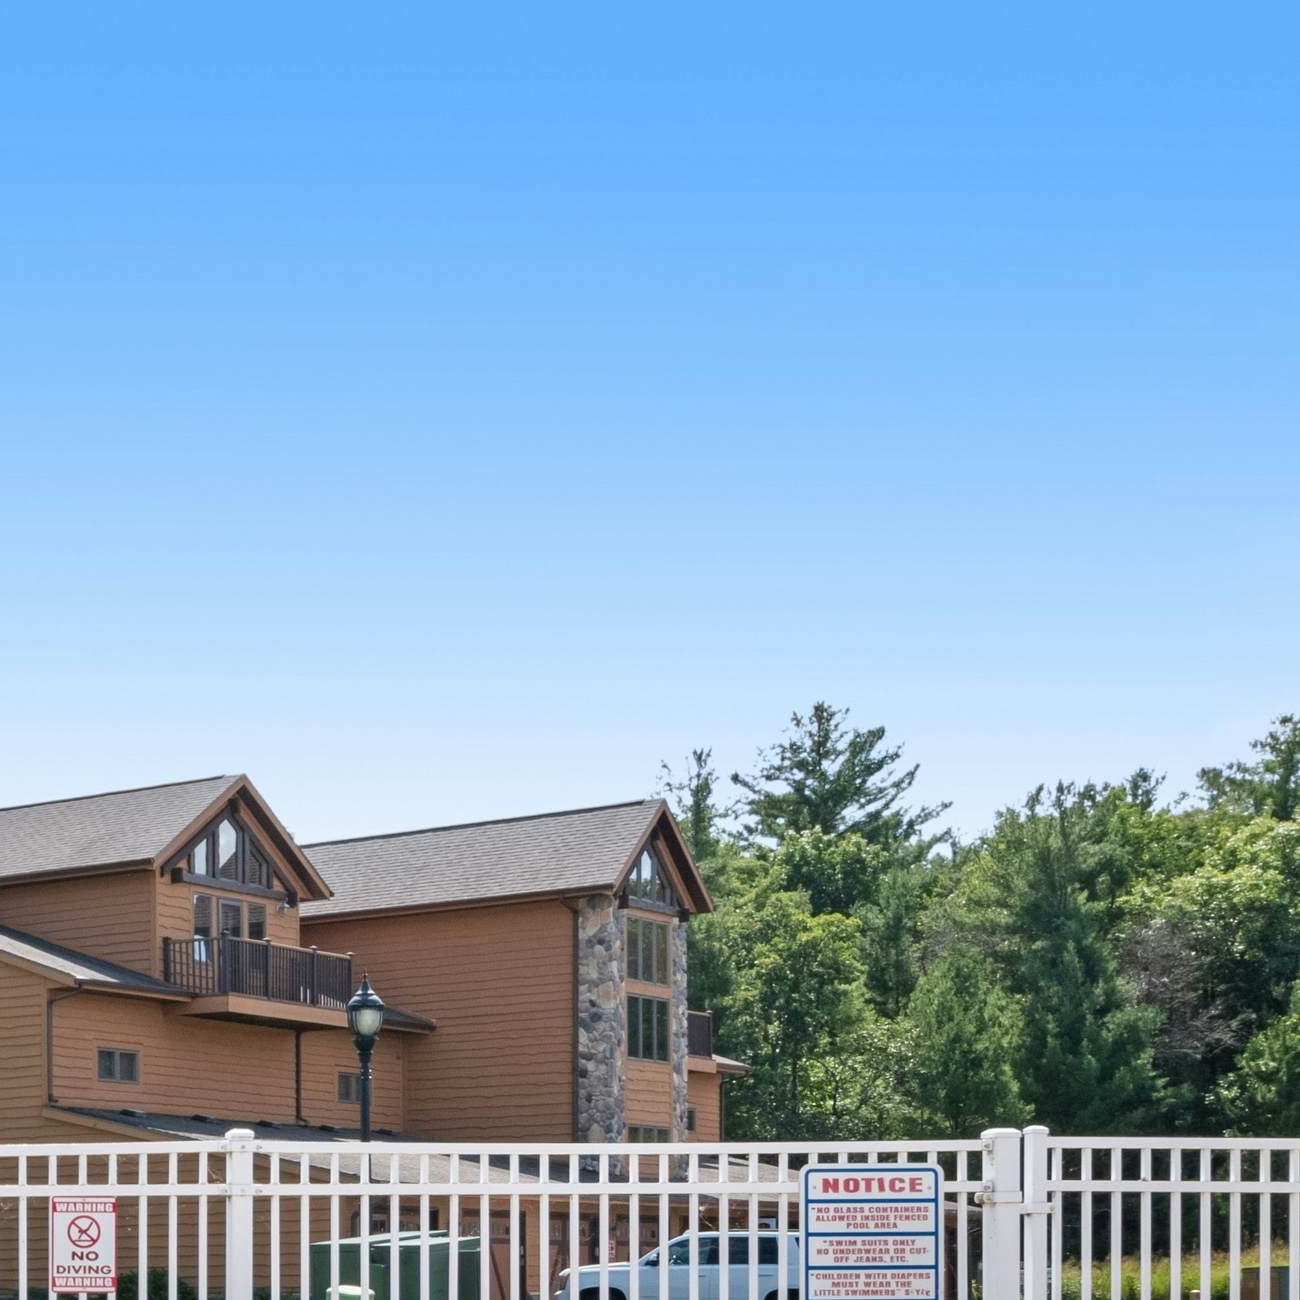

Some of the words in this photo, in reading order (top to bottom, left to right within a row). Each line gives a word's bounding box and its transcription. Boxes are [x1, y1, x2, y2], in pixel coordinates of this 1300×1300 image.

[822, 1177, 923, 1193] NOTICE
[55, 1202, 113, 1212] WARNING
[71, 1251, 99, 1261] NO
[56, 1265, 112, 1275] DIVING
[55, 1277, 112, 1287] WARNING
